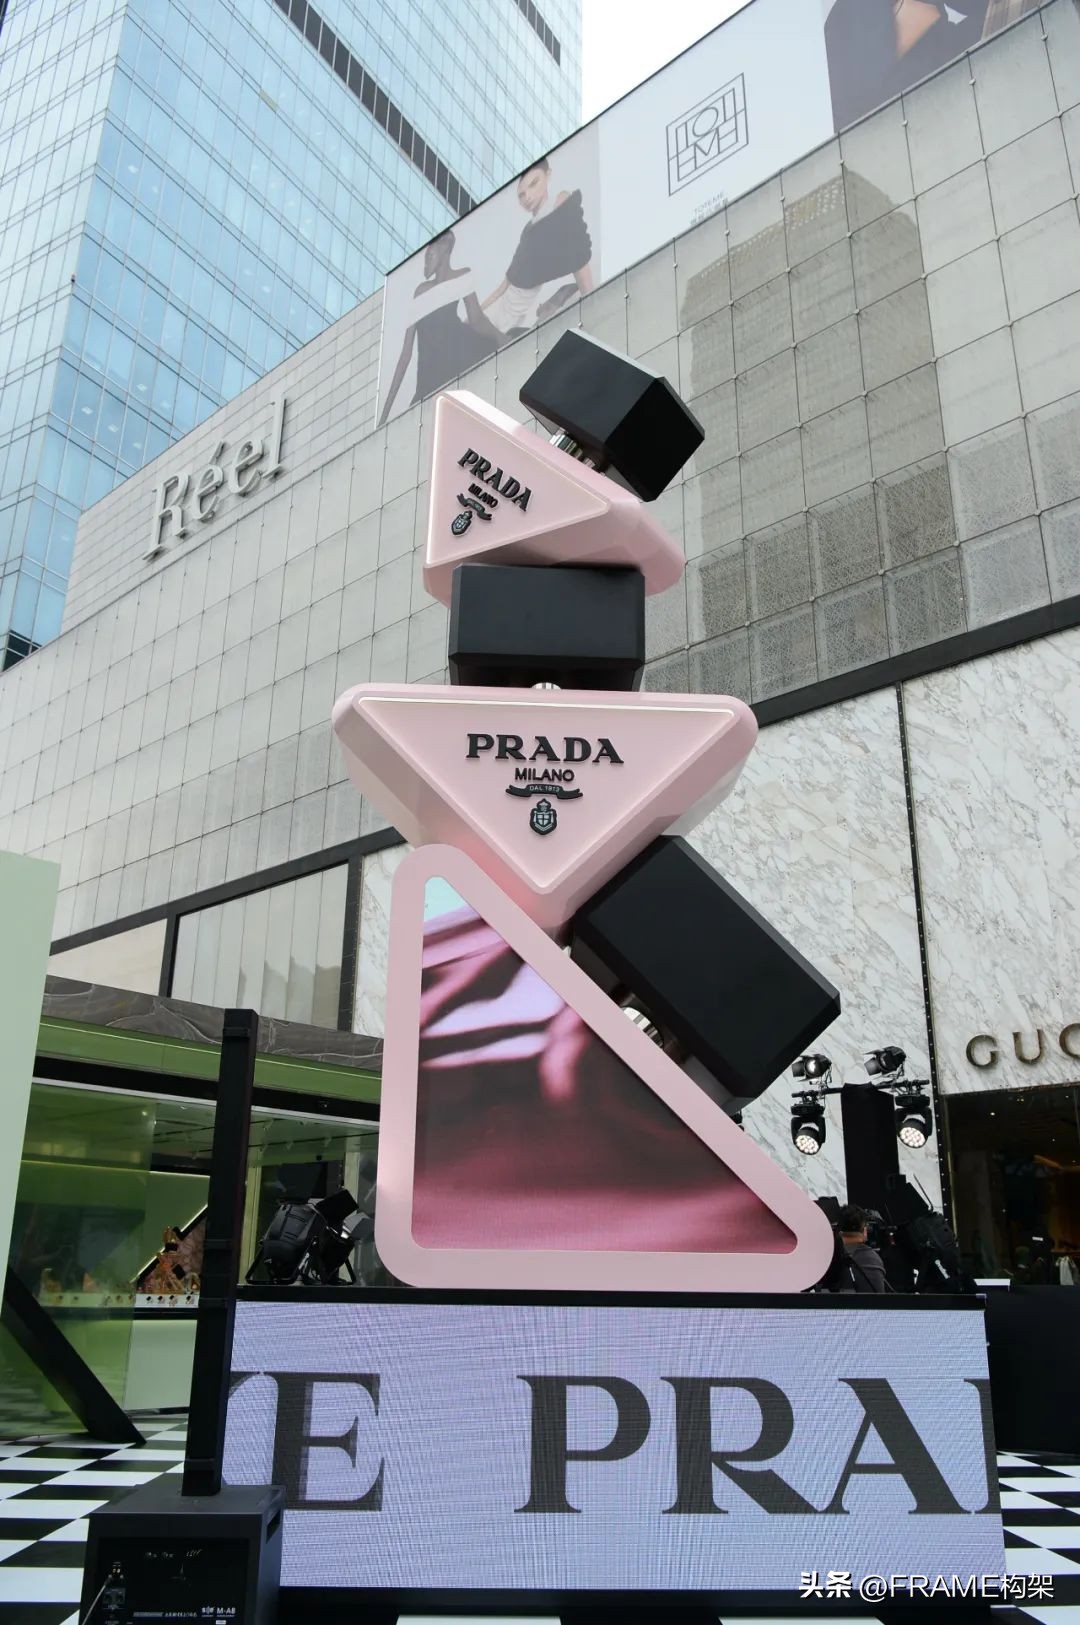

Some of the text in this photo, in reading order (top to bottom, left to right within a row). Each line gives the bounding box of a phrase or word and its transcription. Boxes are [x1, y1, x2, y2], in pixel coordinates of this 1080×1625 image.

[143, 394, 286, 560] Réel
[457, 448, 532, 512] PRADA
[468, 483, 498, 508] MILANO
[466, 733, 624, 764] PRADA
[514, 767, 575, 782] MILANO
